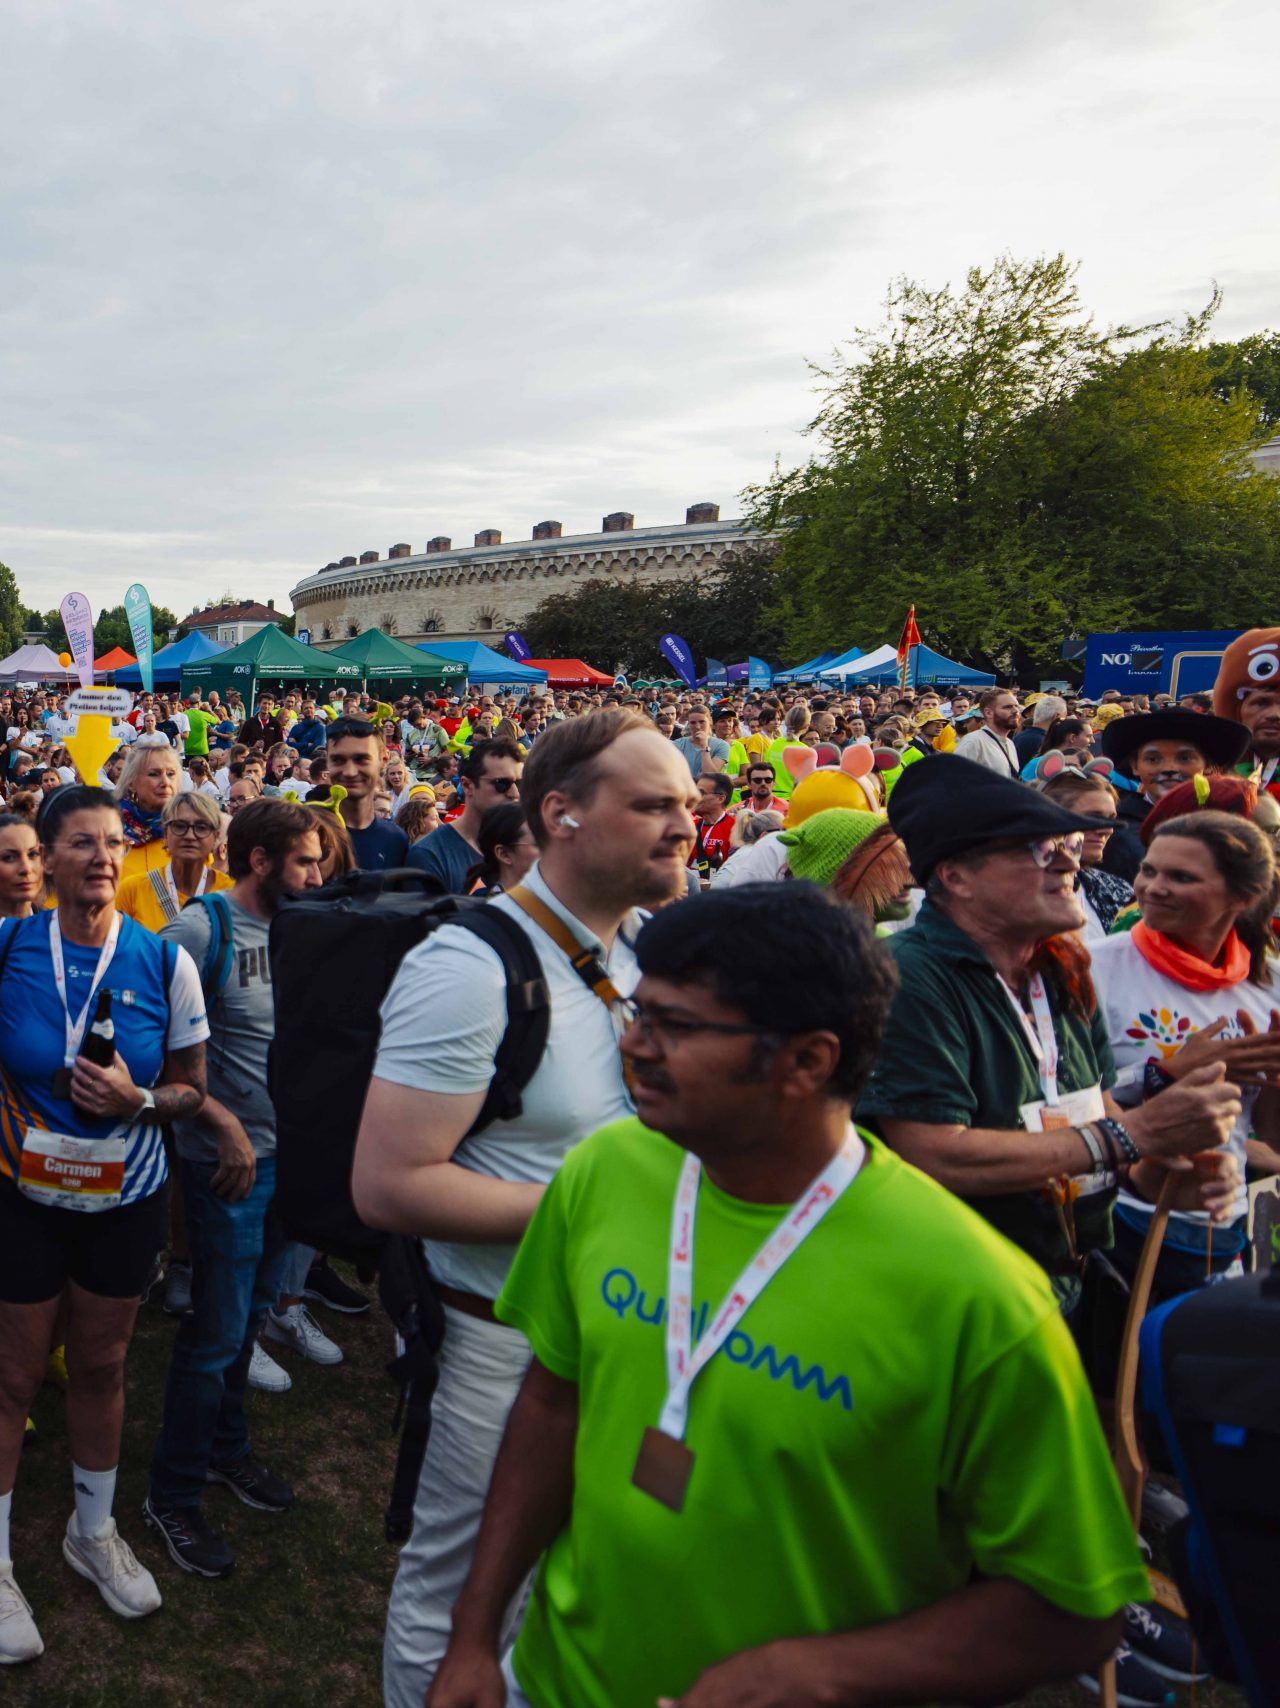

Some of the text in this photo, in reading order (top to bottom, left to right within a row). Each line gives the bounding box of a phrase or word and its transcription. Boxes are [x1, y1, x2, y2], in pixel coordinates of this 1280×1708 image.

[336, 666, 351, 674] AOK
[441, 665, 456, 673] AOK
[239, 945, 273, 988] PU
[43, 1157, 103, 1178] Carmen
[602, 1268, 853, 1412] Qulomm
